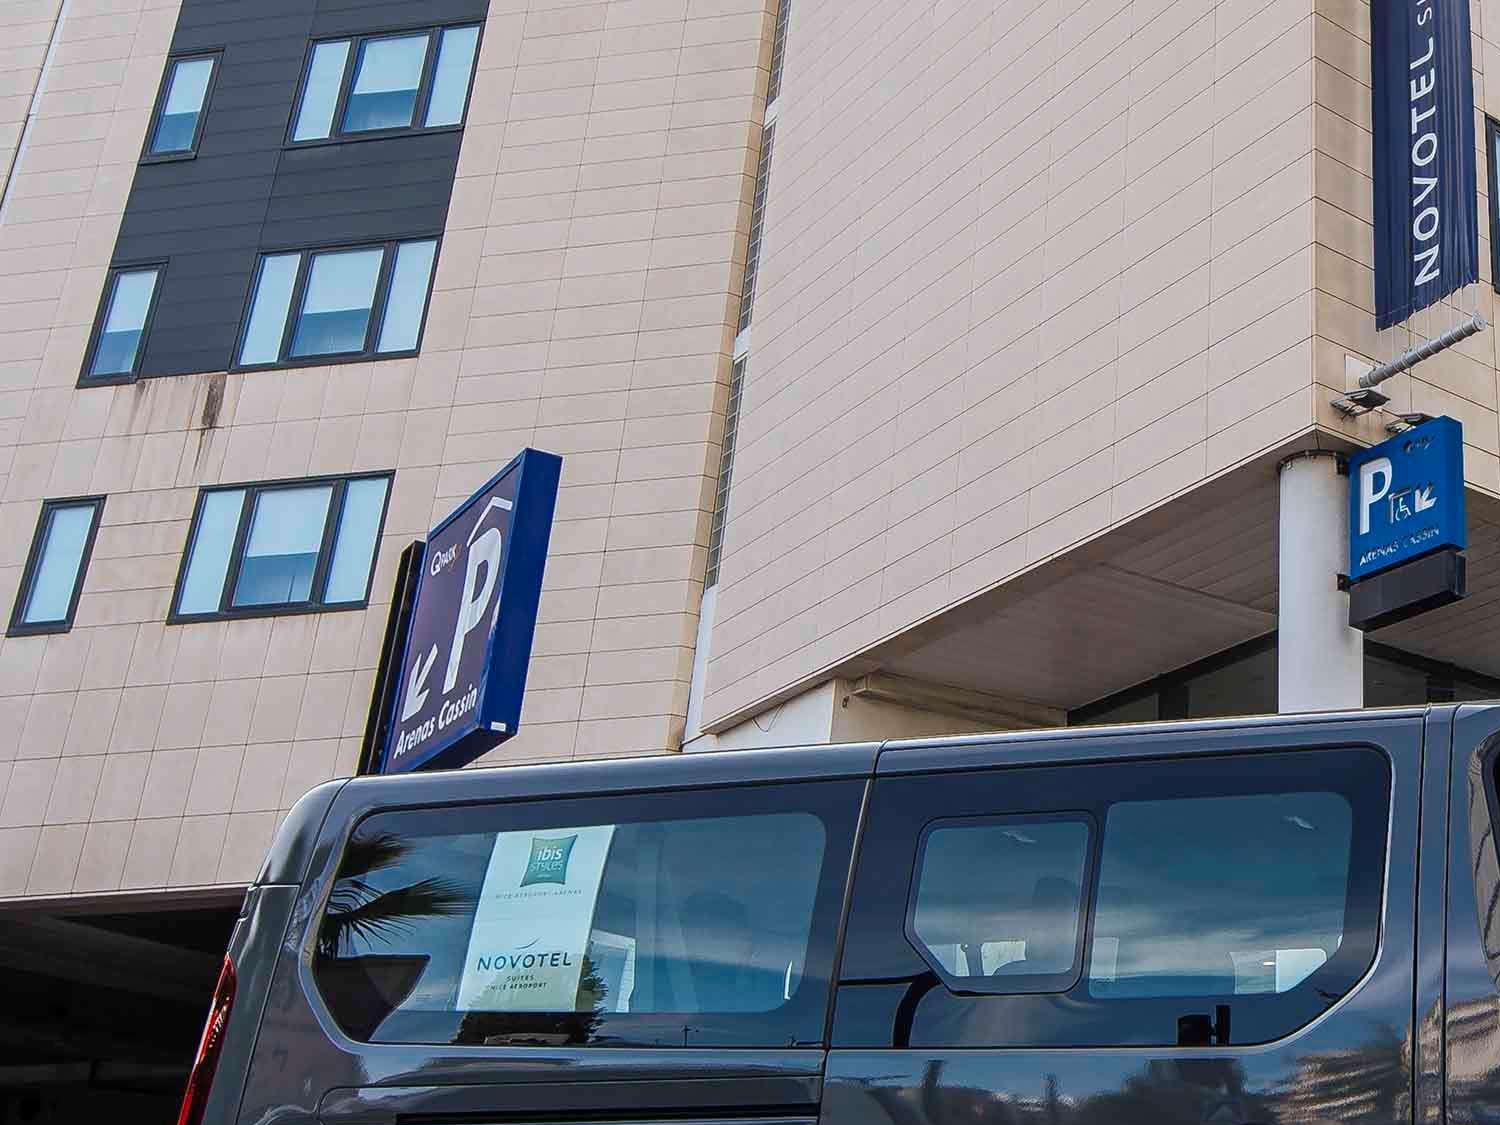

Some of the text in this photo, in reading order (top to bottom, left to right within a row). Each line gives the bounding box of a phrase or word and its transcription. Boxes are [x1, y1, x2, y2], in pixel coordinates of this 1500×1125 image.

[1410, 37, 1440, 287] NOVOTEL
[1360, 457, 1393, 535] P
[442, 527, 502, 695] P
[393, 683, 478, 760] Arenas Cassin
[536, 845, 564, 861] ibis
[476, 952, 573, 972] NOVOTEL
[506, 974, 535, 983] SUITES
